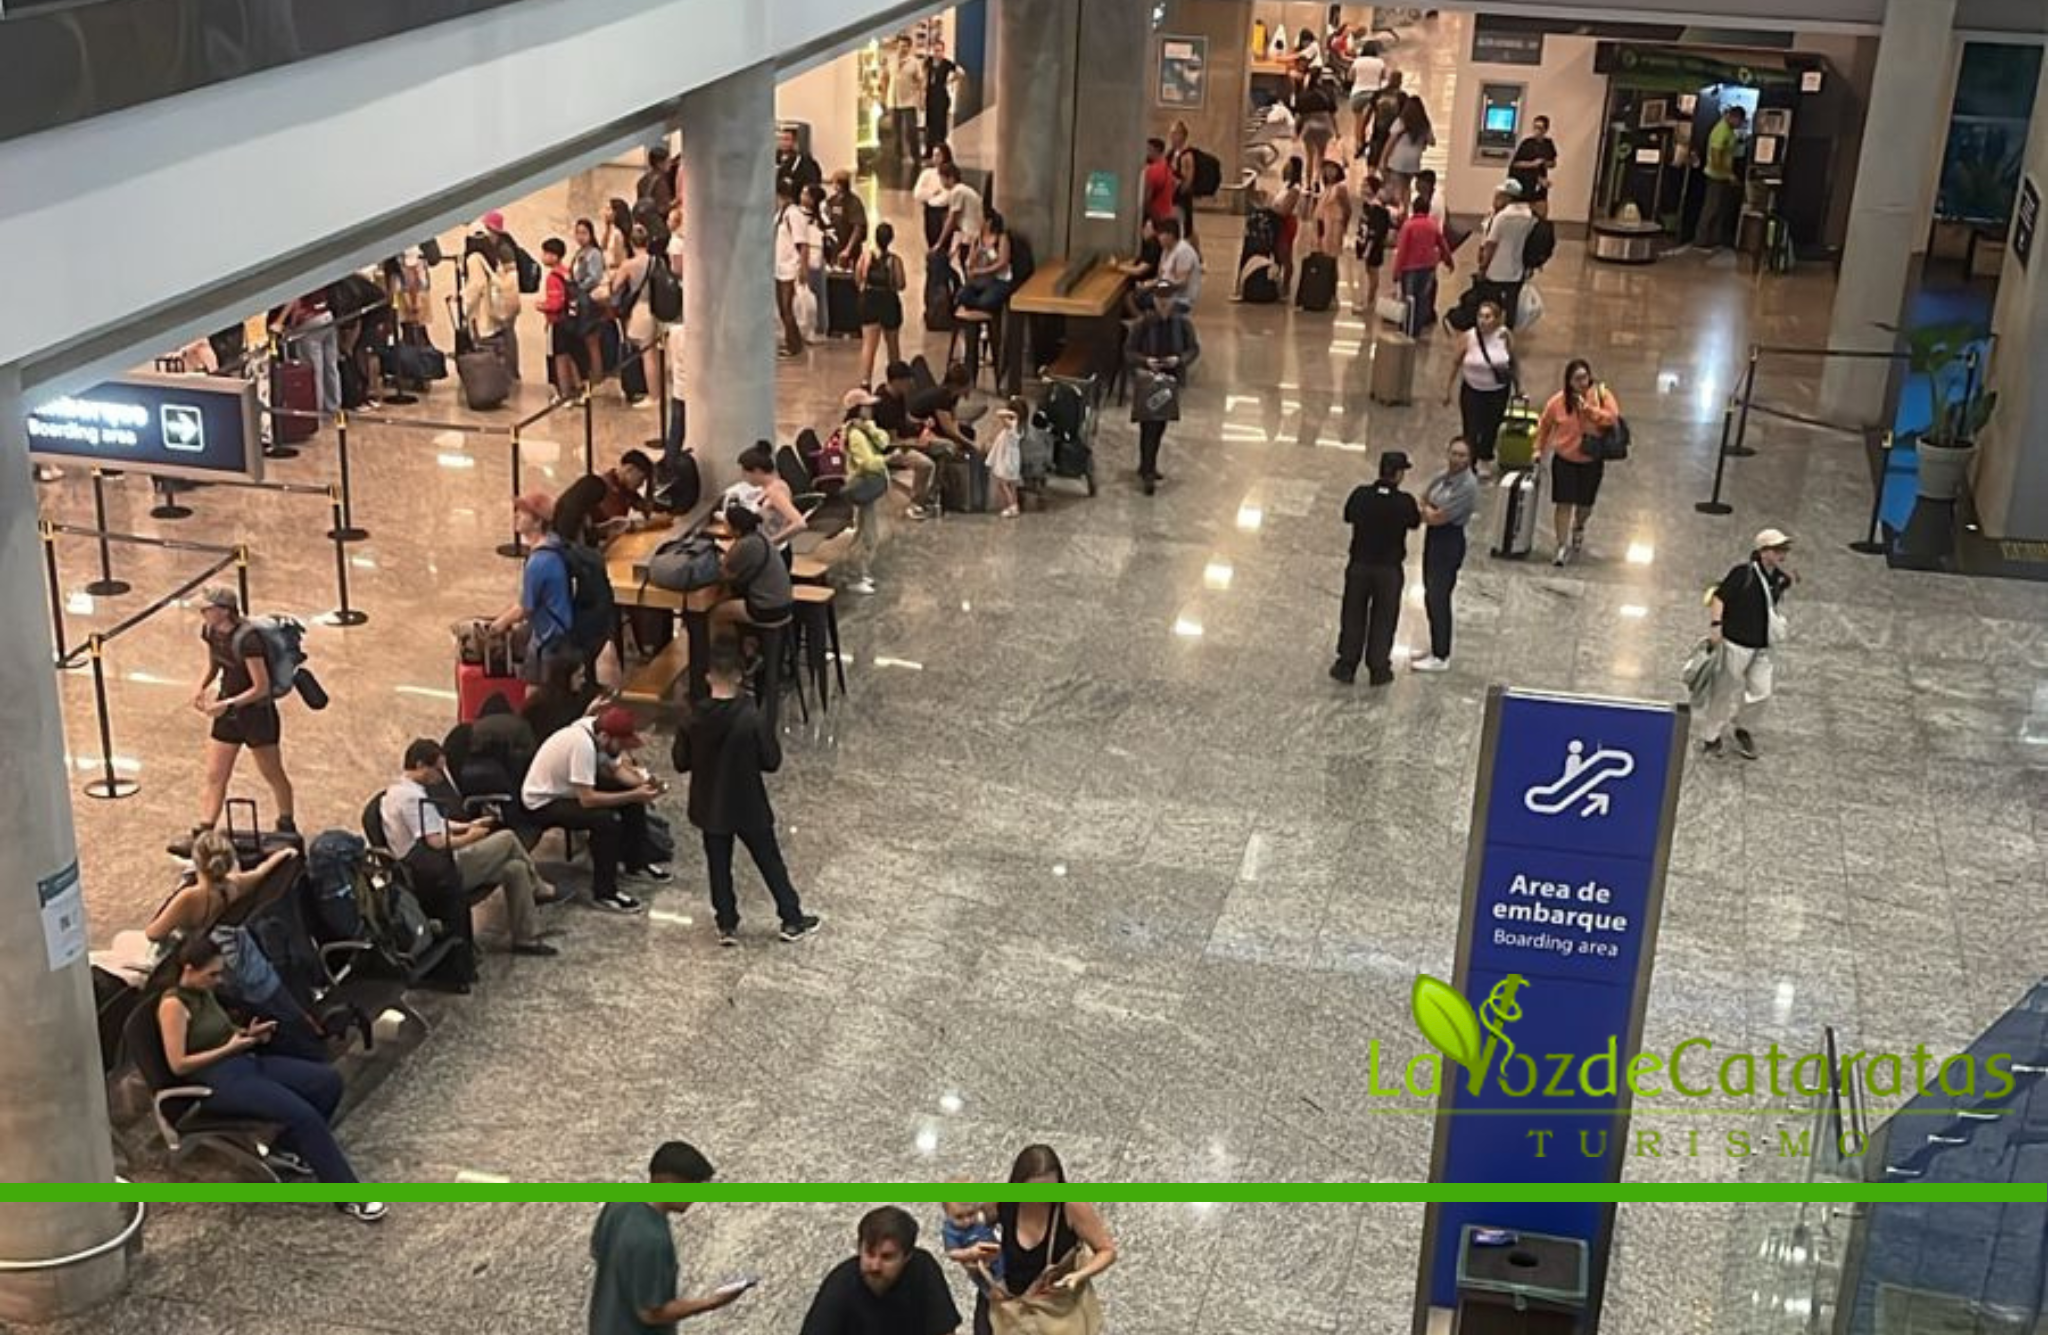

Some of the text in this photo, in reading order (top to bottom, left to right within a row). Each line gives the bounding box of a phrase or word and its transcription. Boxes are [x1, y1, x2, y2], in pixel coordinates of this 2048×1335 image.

[1509, 874, 1611, 904] Area de
[1492, 901, 1628, 933] embarque
[1493, 928, 1619, 957] Boarding area
